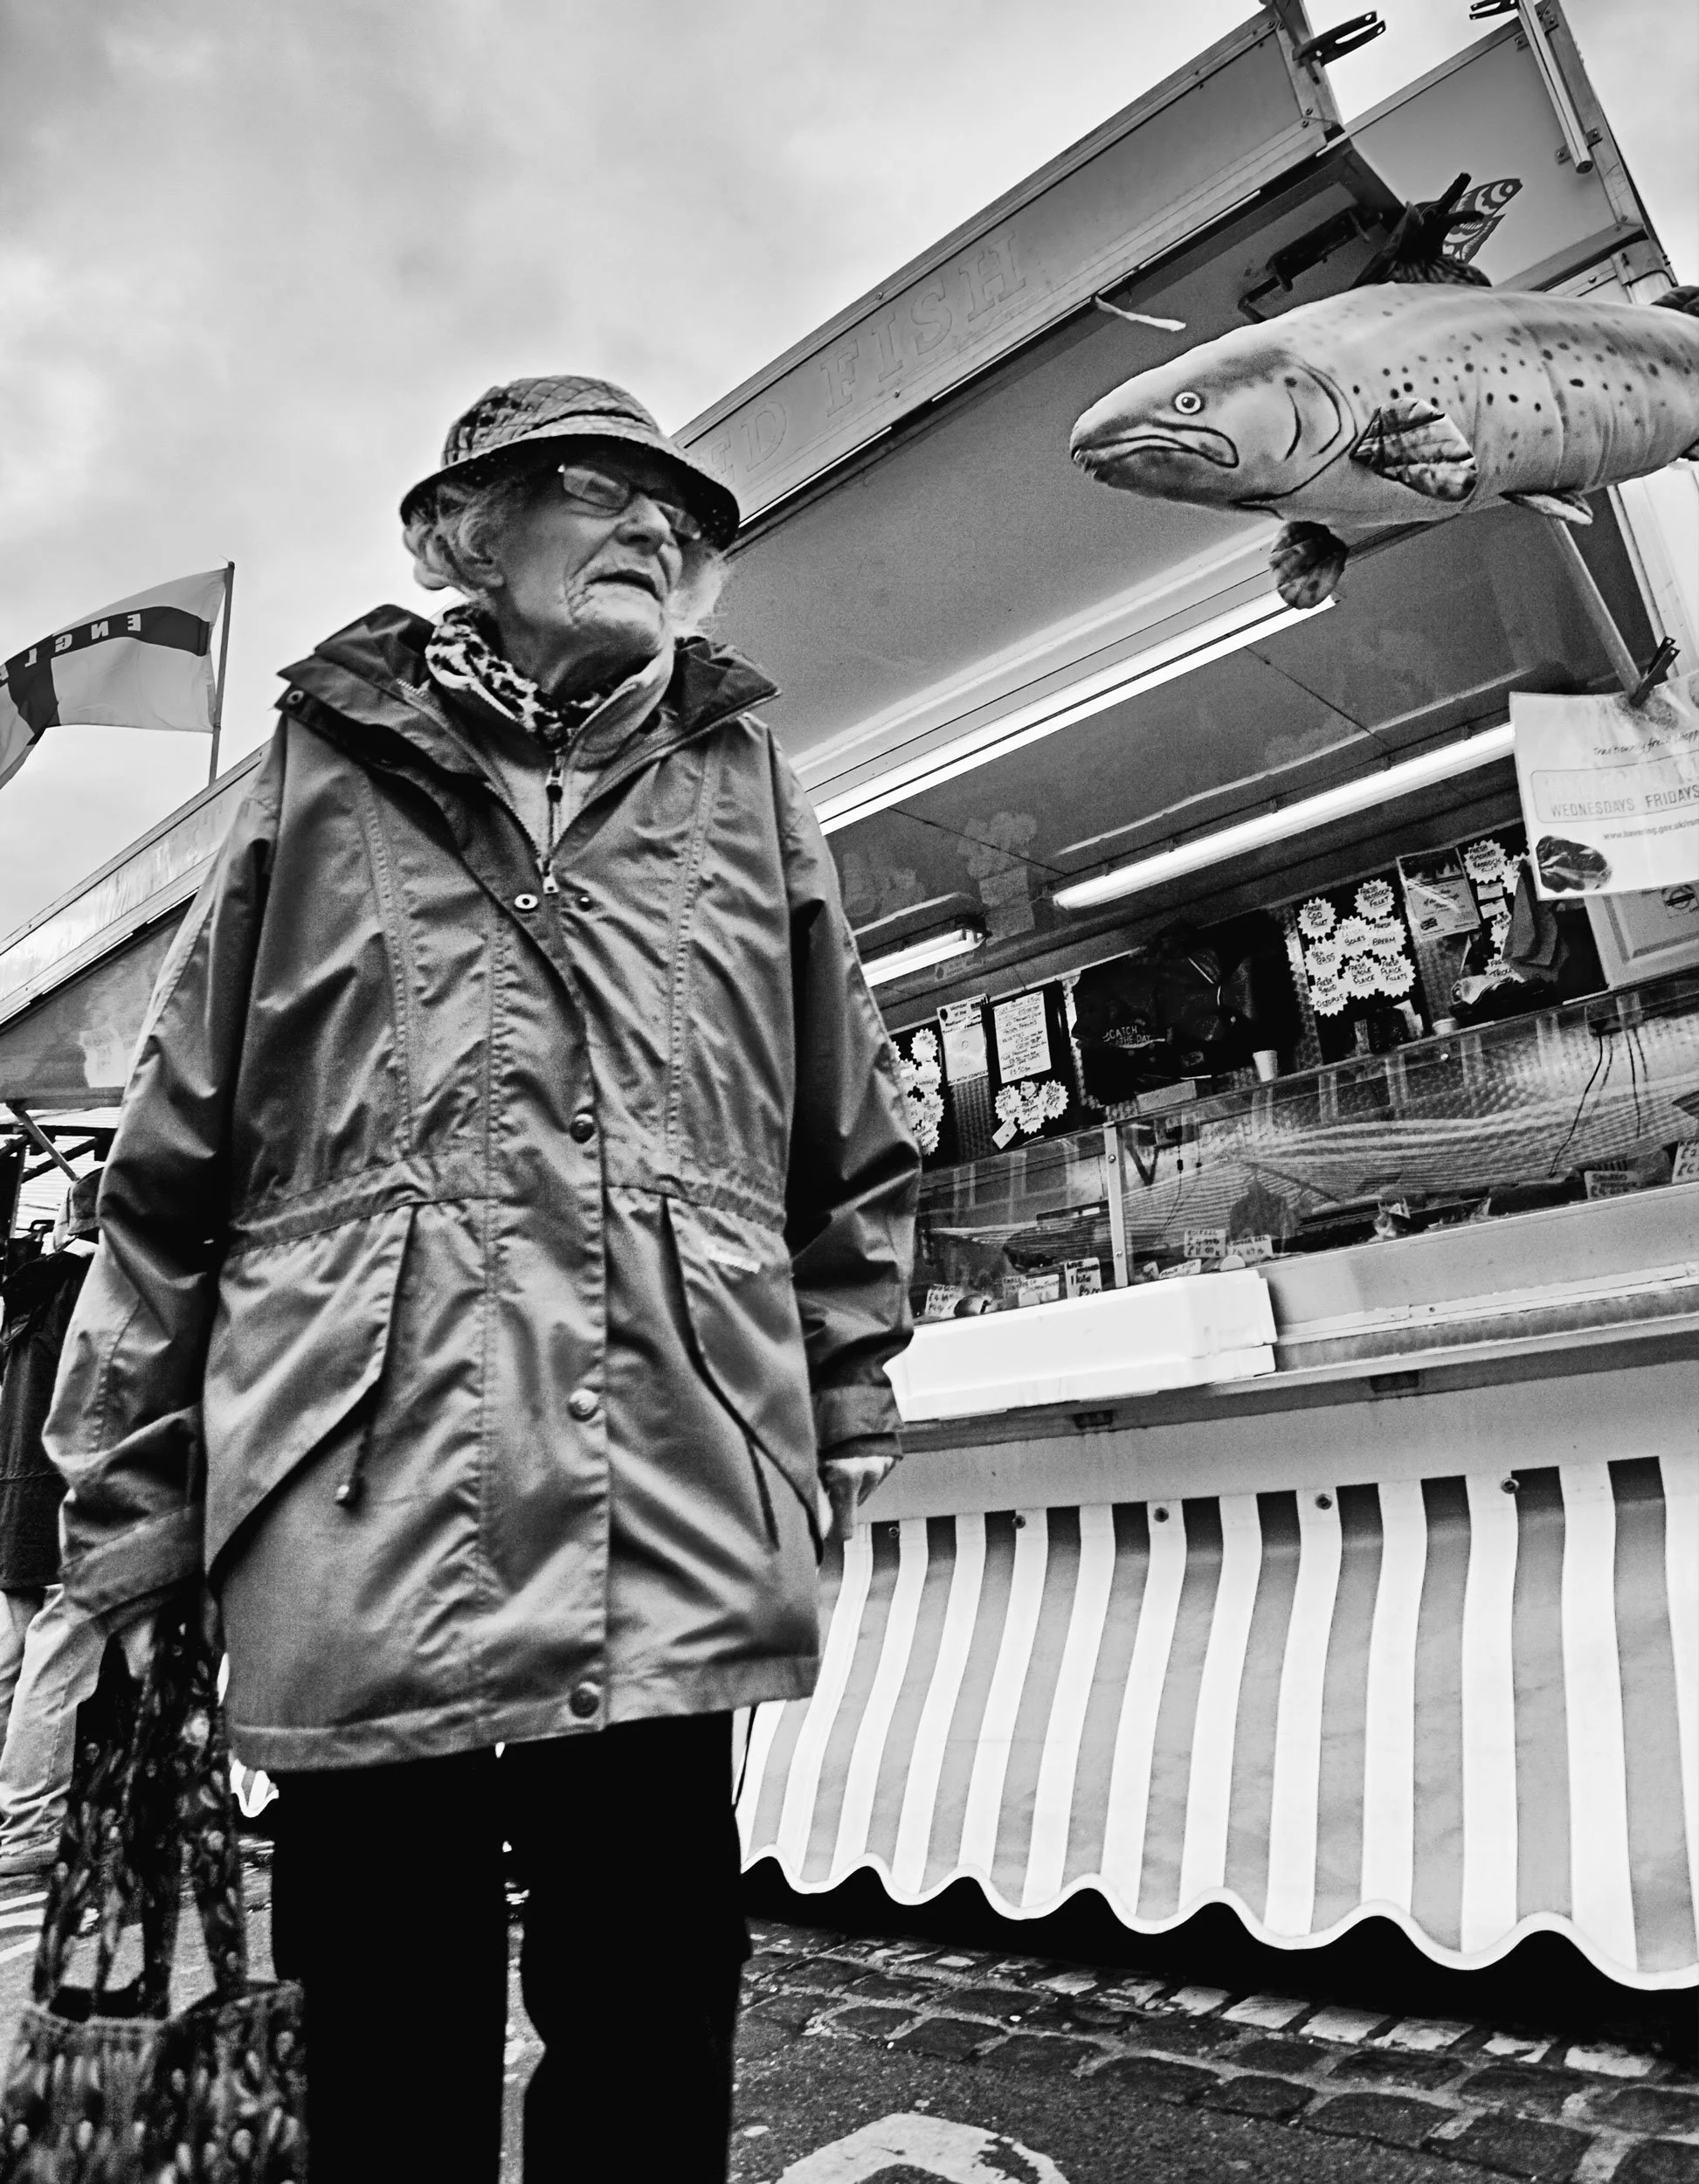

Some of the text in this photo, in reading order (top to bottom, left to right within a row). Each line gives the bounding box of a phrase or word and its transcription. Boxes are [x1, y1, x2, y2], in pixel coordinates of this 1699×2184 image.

[819, 231, 1027, 418] FISH
[1551, 784, 1699, 818] WEDNESDAYS FRIDAYS
[1109, 1026, 1137, 1039] CATCH
[1136, 1034, 1151, 1043] DAY
